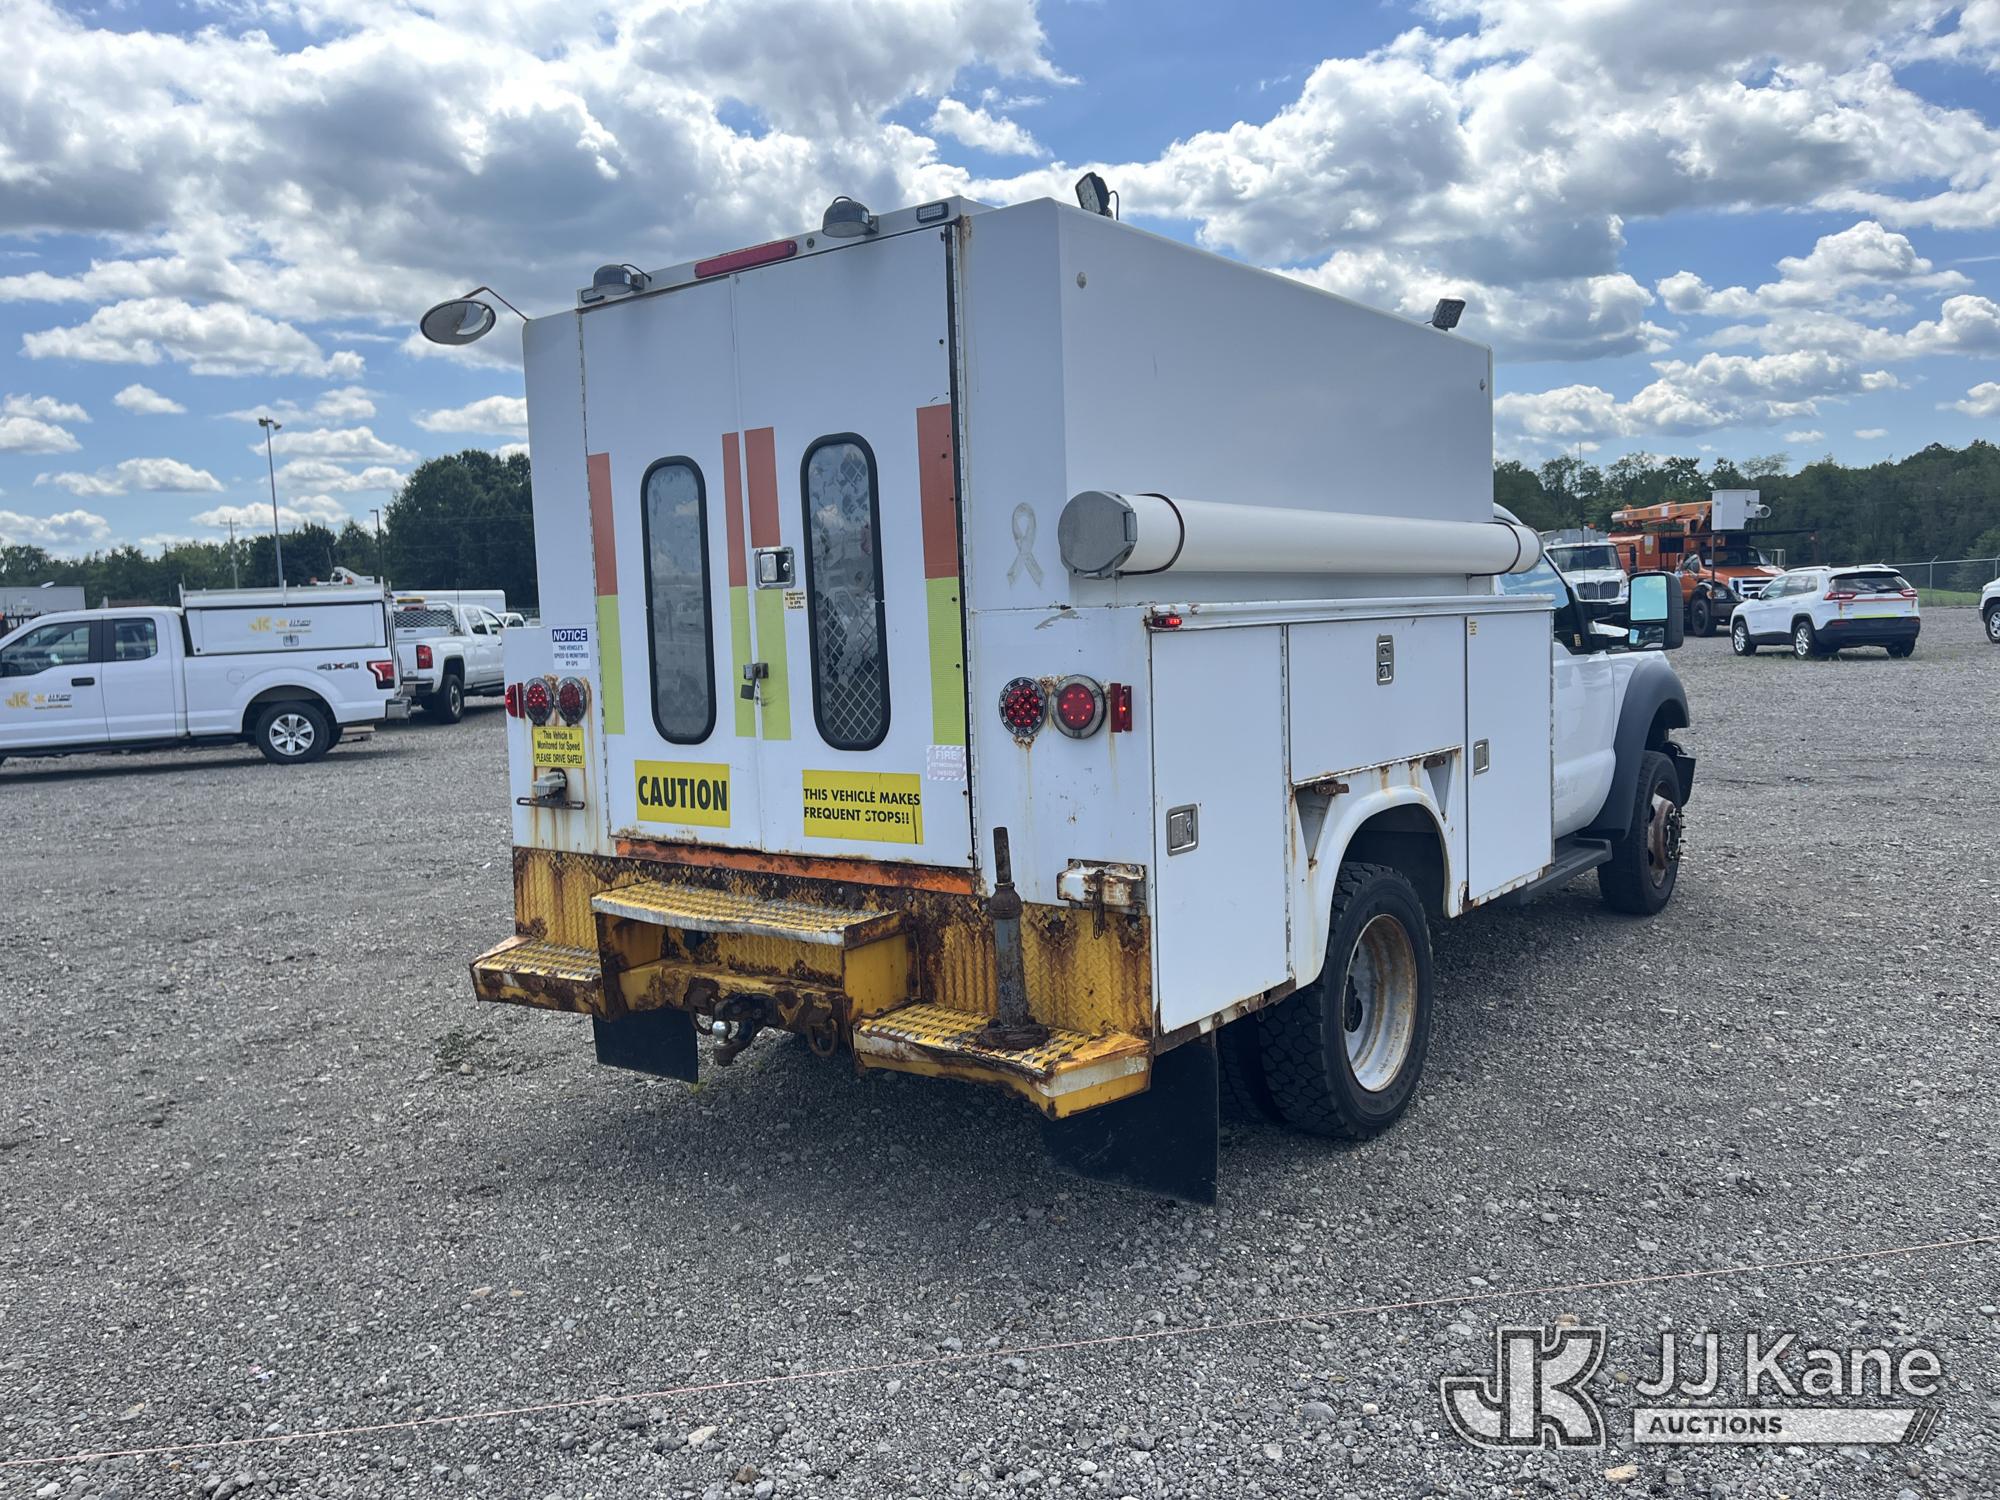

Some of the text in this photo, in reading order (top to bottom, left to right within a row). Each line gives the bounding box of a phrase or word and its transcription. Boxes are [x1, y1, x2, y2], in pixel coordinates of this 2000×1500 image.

[553, 630, 587, 641] NOTICE
[543, 730, 573, 740] This Vehicle is
[537, 741, 558, 750] Monitored
[566, 741, 580, 752] Speed
[536, 753, 582, 764] PLEASE DRIVE SAFELY
[935, 750, 957, 760] FIRE
[638, 776, 727, 811] CAUTION
[804, 788, 920, 806] THIS VEHICLE MAKES
[804, 806, 910, 825] FREQUENT STOPS!!
